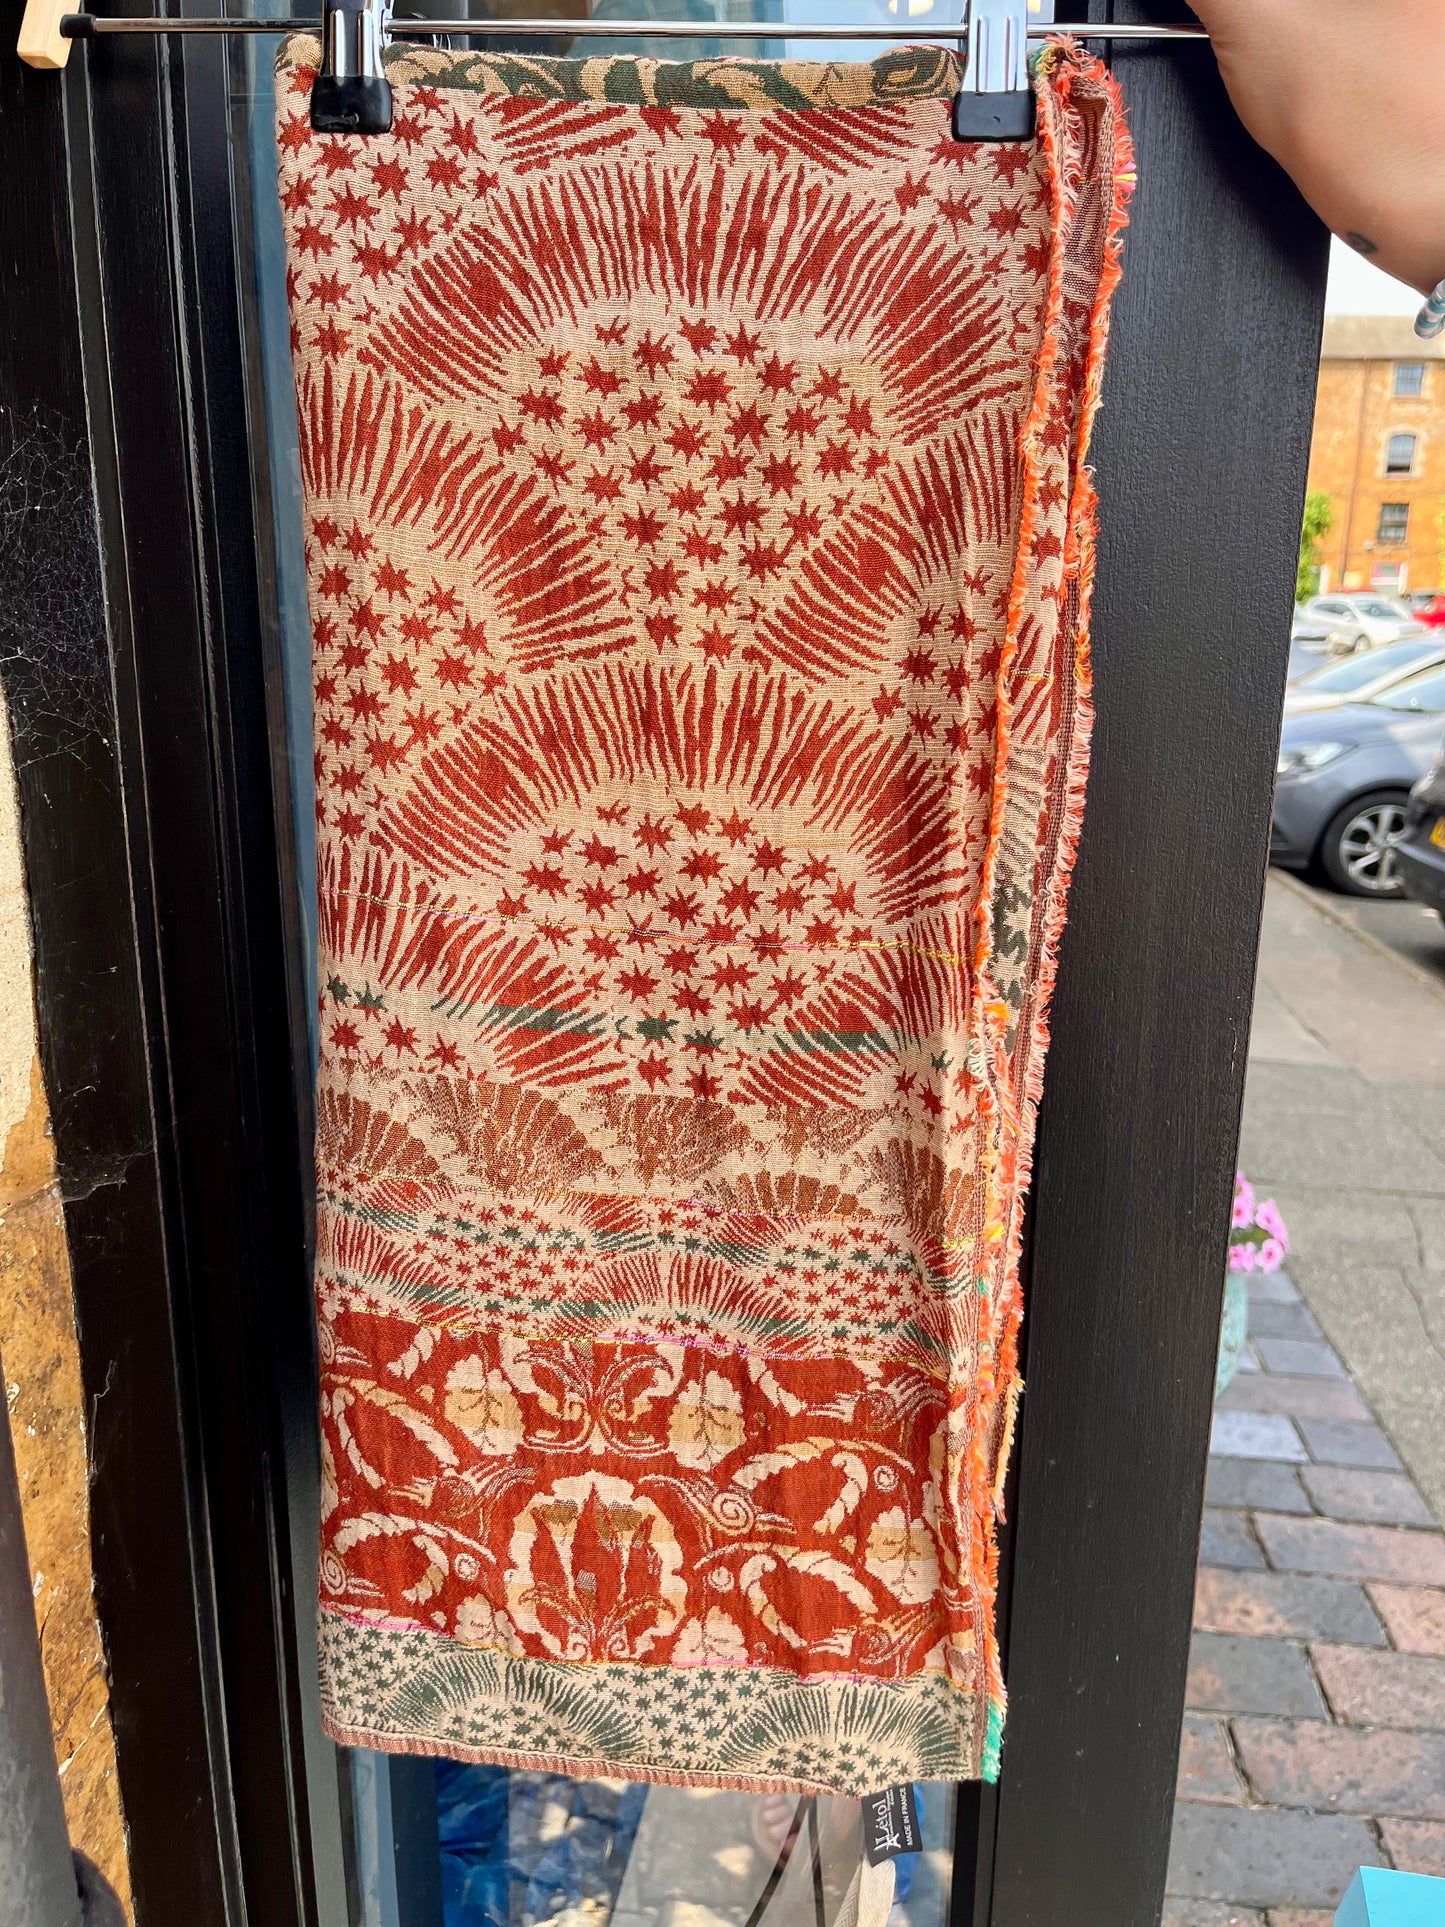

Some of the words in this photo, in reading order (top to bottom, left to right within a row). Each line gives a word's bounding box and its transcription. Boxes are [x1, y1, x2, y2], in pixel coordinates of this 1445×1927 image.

[900, 1787, 908, 1815] FRANCE
[902, 1815, 910, 1824] IN
[904, 1825, 913, 1846] MADE
